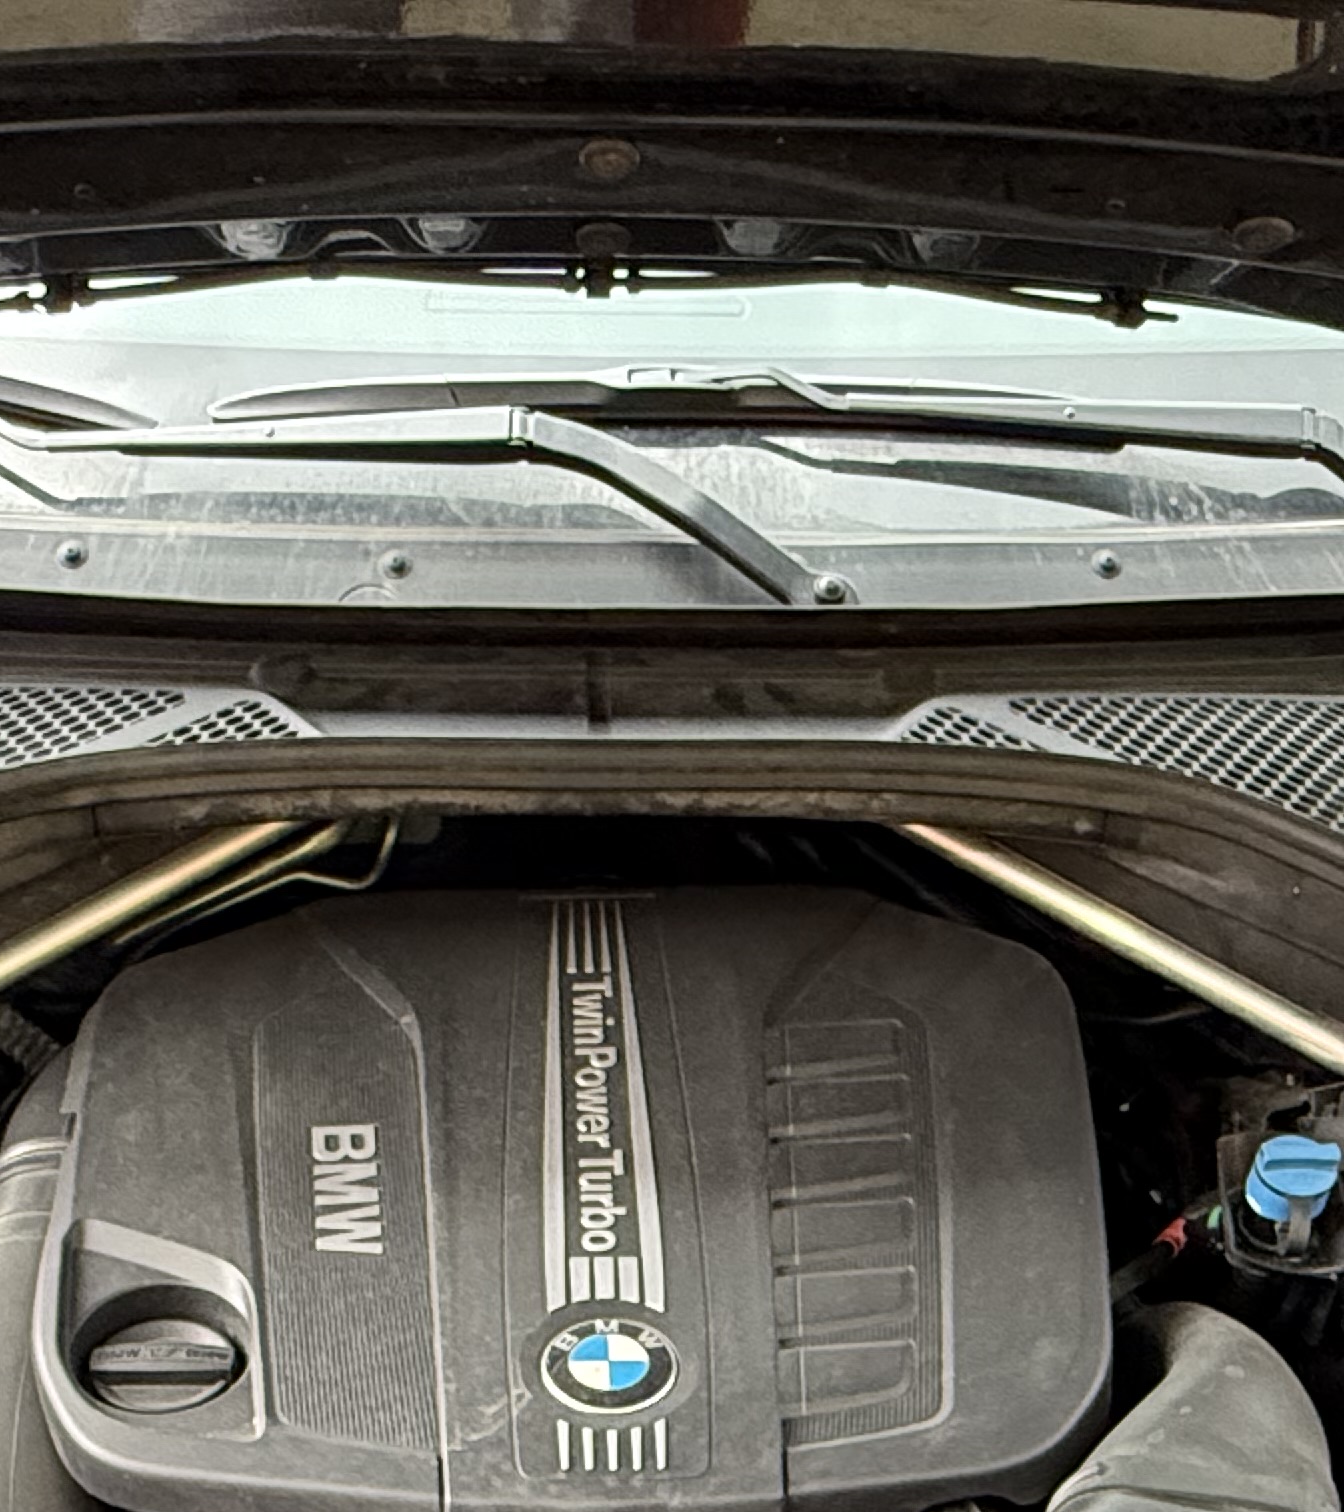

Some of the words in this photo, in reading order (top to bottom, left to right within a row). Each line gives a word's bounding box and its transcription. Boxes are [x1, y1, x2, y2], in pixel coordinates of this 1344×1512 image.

[571, 975, 618, 1148] TwinPower
[311, 1124, 384, 1254] BMW
[578, 1149, 628, 1252] Turbo
[554, 1318, 667, 1352] BMW
